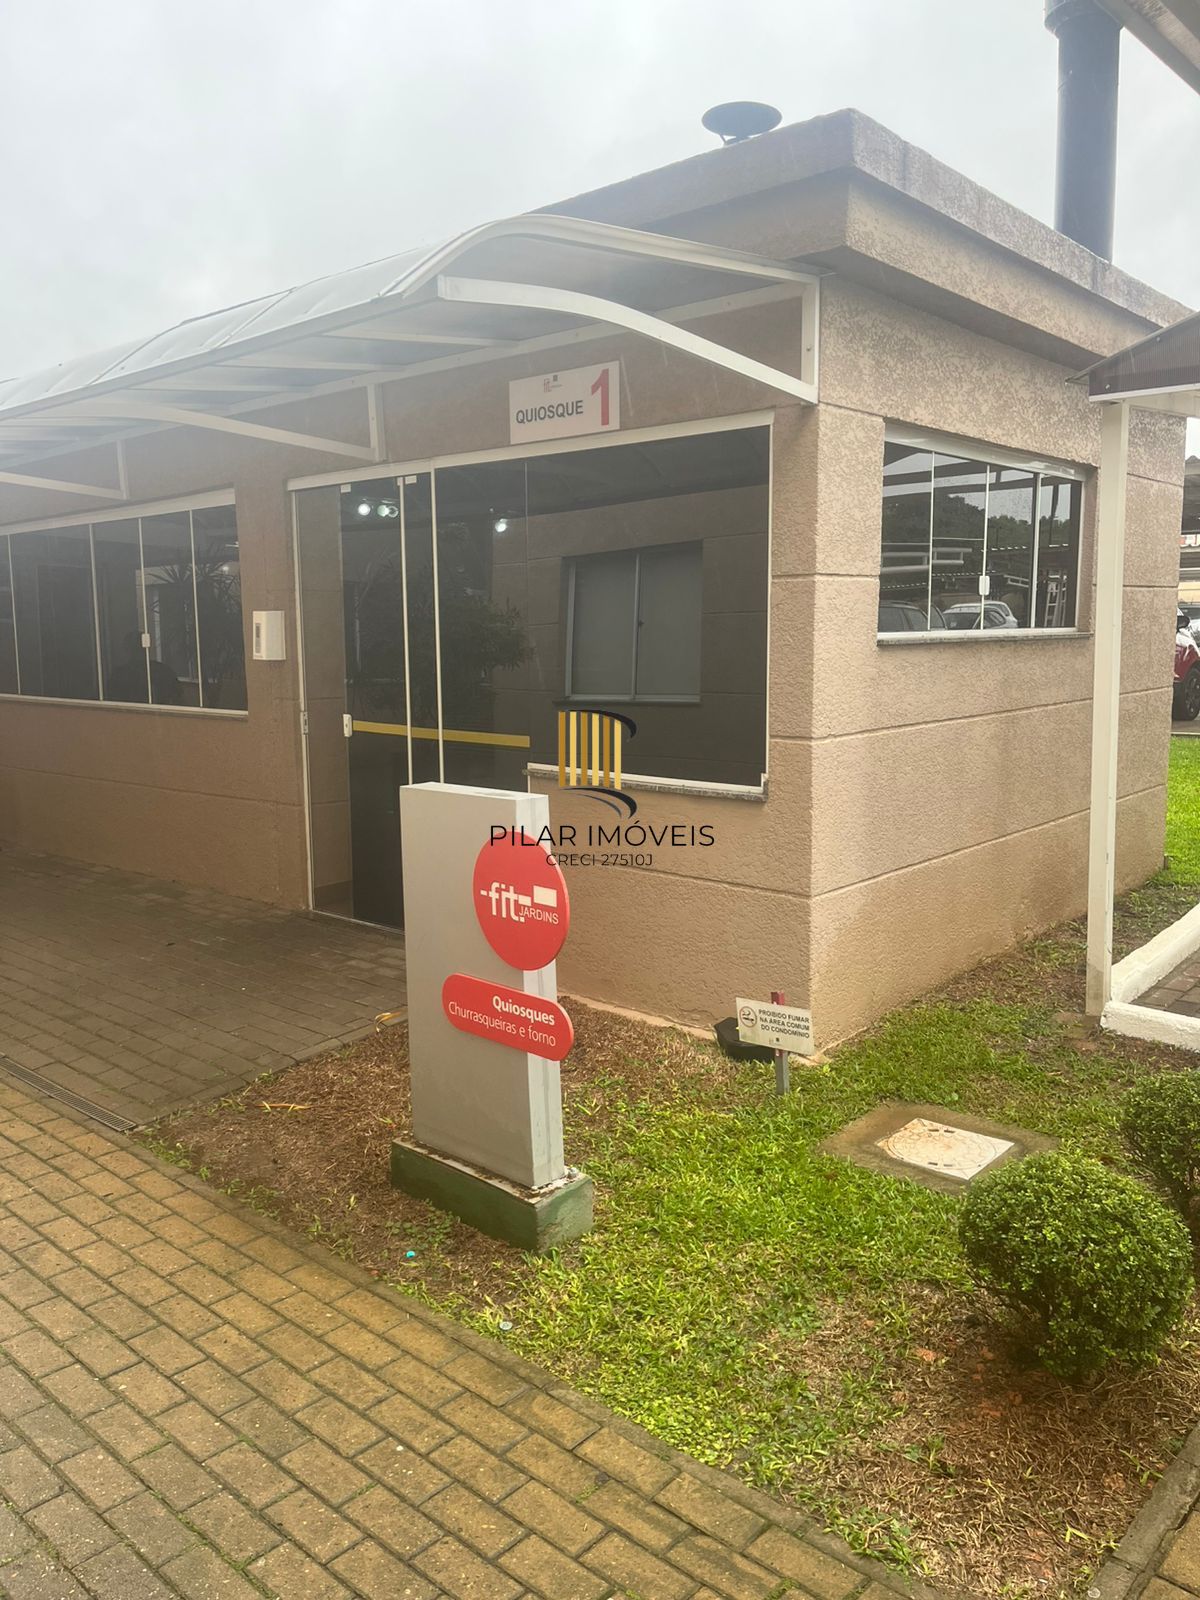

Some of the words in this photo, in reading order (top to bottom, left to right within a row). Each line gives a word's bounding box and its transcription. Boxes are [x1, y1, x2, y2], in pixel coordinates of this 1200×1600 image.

[516, 400, 583, 424] QUIOSQUE
[591, 368, 609, 426] 1
[518, 906, 559, 925] JARDINS
[492, 995, 555, 1026] Quiosques
[758, 1009, 786, 1019] PROIBIDO
[788, 1015, 809, 1023] FUMAR
[448, 1001, 517, 1034] Churrasqueiras
[519, 1026, 526, 1038] e
[527, 1025, 556, 1047] forno
[786, 1021, 809, 1030] COMUM
